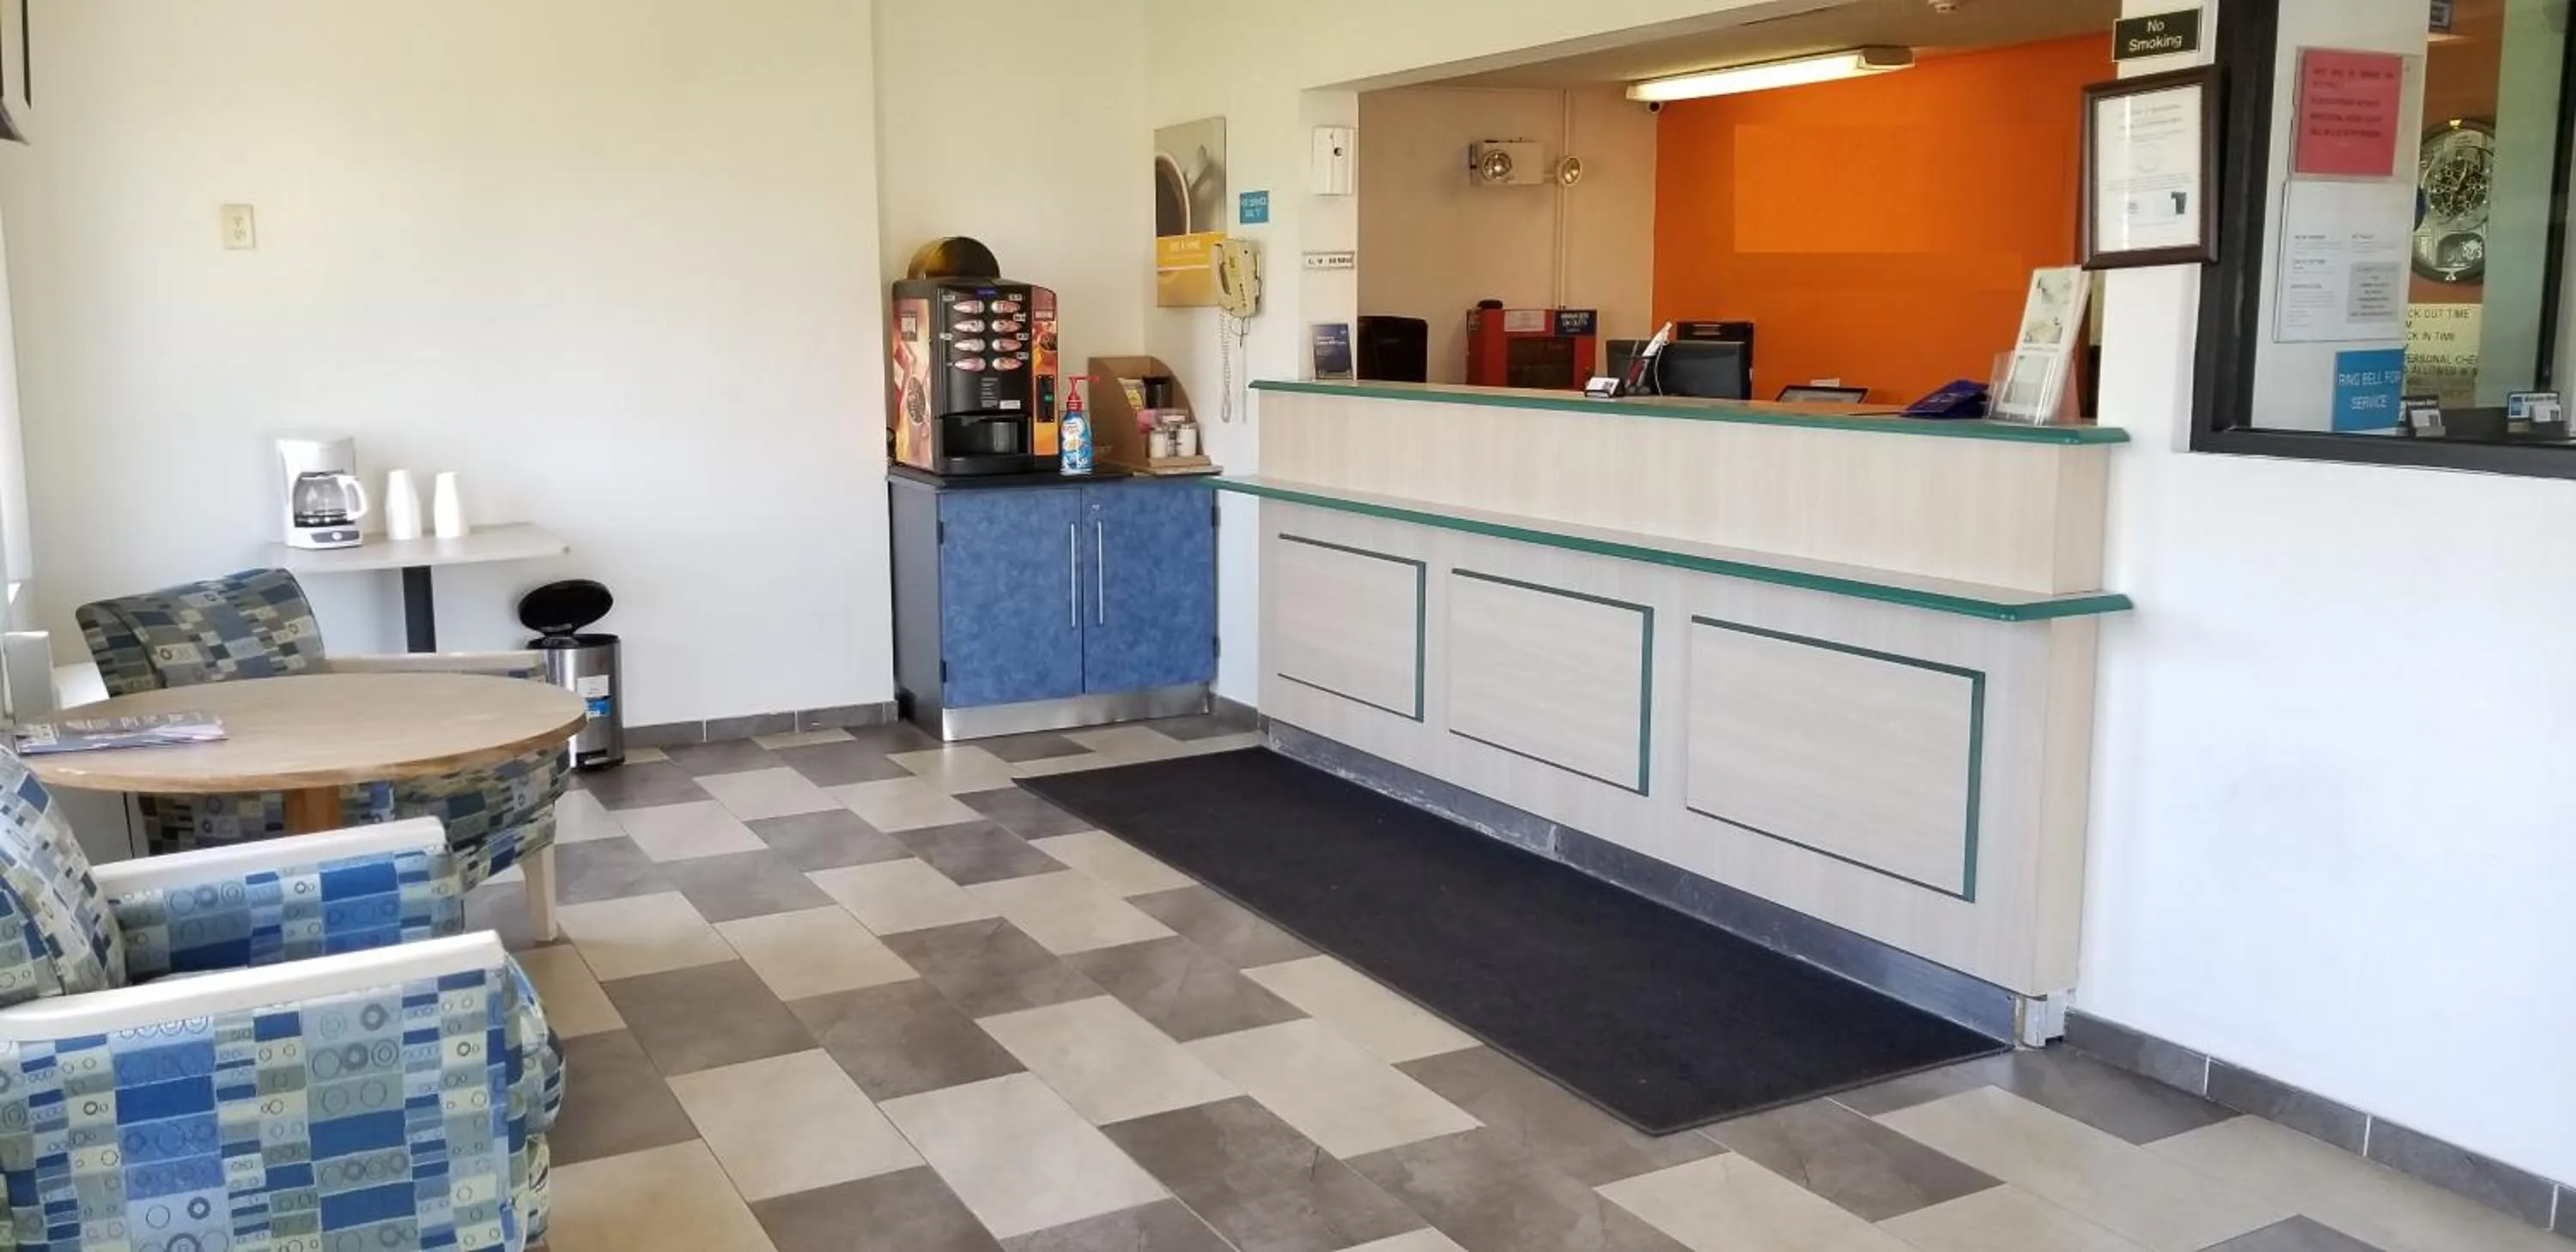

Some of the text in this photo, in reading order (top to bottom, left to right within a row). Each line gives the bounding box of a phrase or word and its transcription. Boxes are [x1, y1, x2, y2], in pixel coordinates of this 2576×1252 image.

[2147, 19, 2165, 33] No
[2129, 35, 2182, 52] Smoking
[2338, 372, 2360, 386] RING
[2361, 370, 2382, 386] BELL
[2350, 394, 2388, 410] SERVICE
